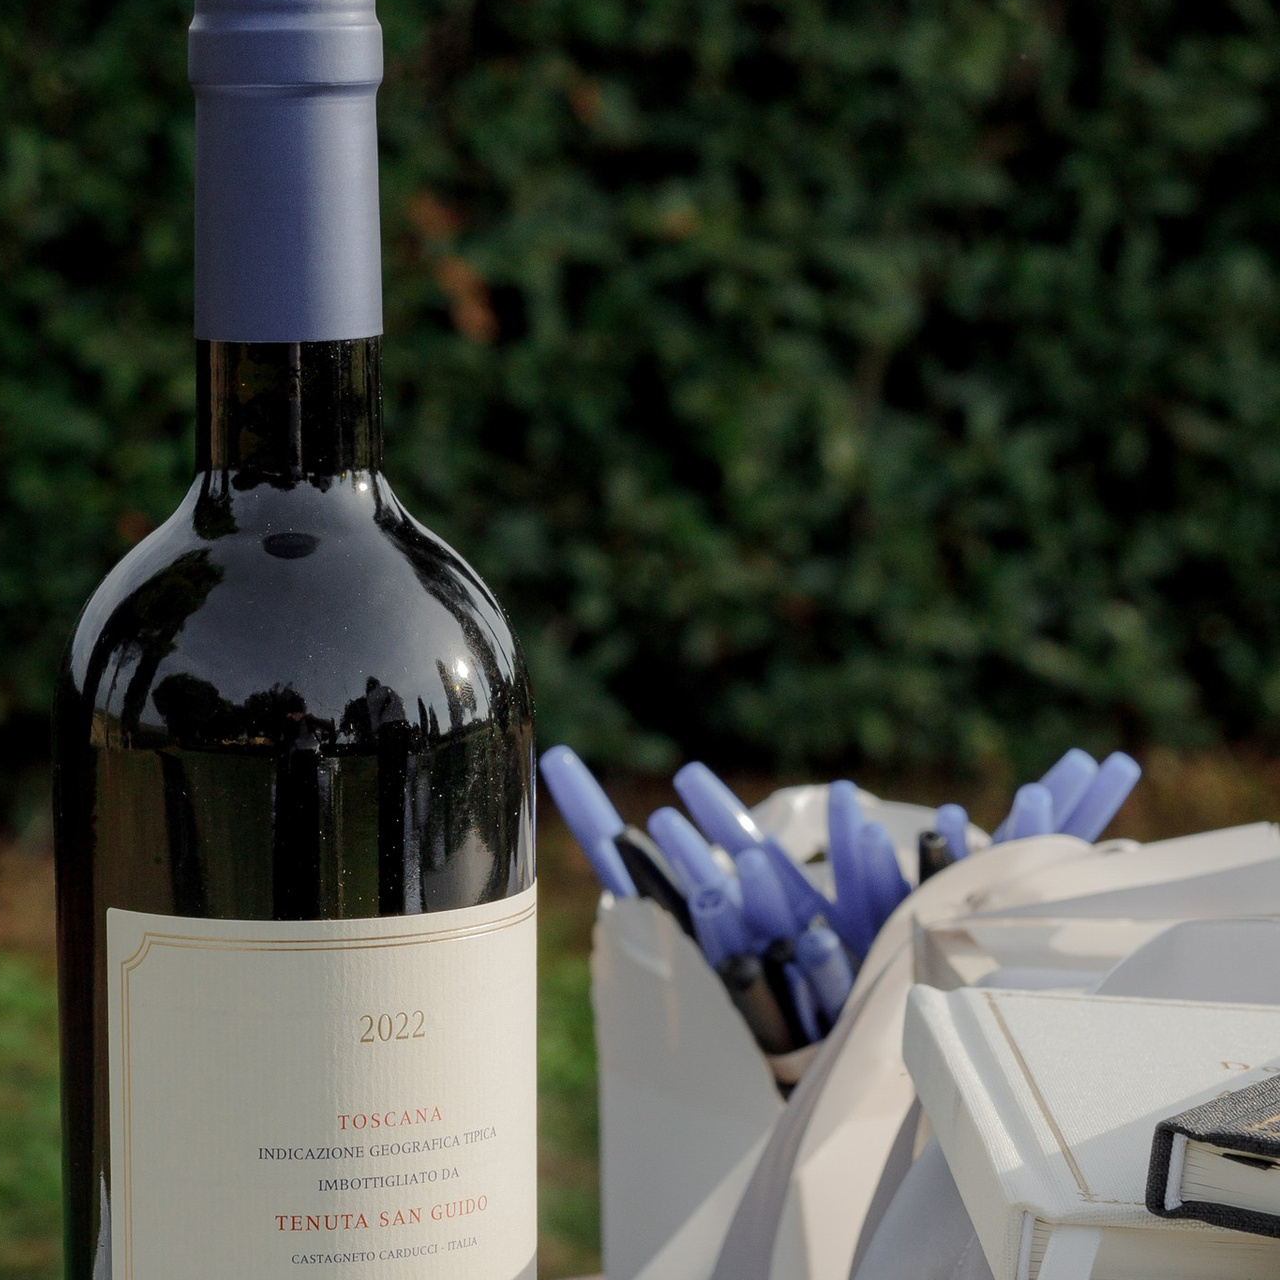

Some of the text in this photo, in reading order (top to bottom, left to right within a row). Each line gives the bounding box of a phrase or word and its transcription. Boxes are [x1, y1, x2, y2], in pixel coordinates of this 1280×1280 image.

[359, 1010, 426, 1043] 2022
[337, 1106, 443, 1131] TOSCANA
[258, 1126, 497, 1160] INDICAZIONE GEOGRAFICA TIPICA
[318, 1167, 460, 1192] IMBOTTIGLIATO DA
[275, 1195, 489, 1232] TENUTA SAN GUIDO
[291, 1251, 376, 1265] CASTAGNETO
[379, 1244, 438, 1261] CARDUCCI
[447, 1236, 478, 1252] ITALIA
